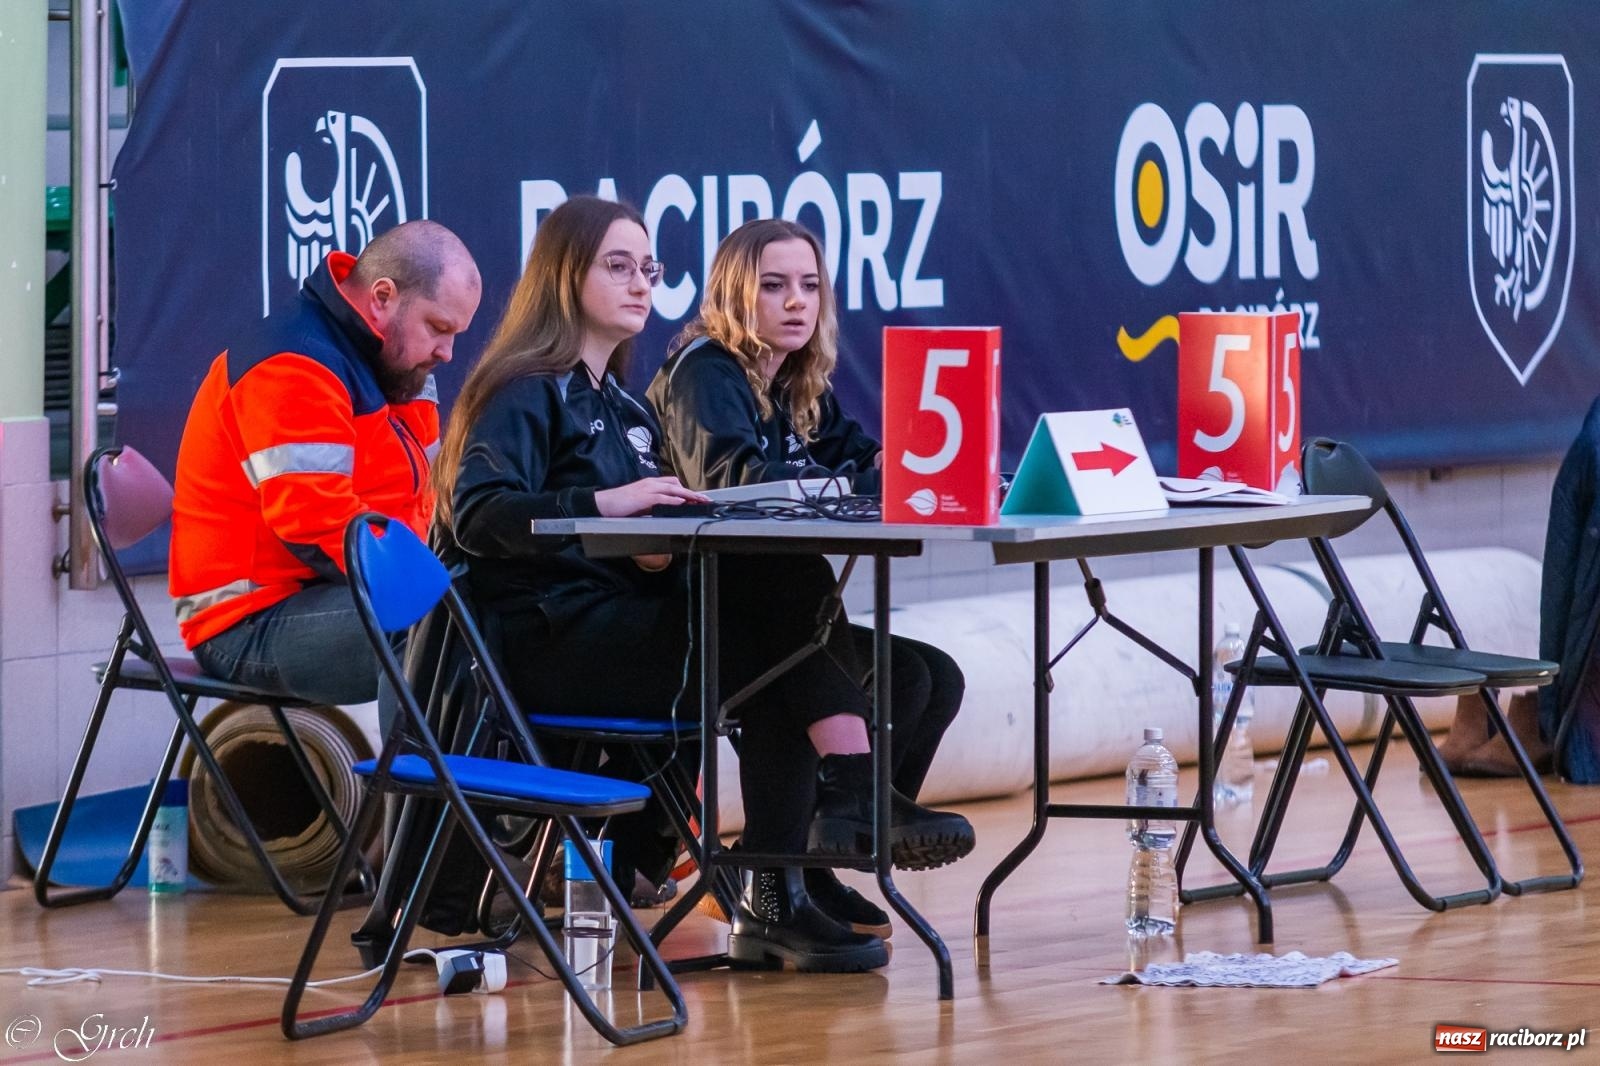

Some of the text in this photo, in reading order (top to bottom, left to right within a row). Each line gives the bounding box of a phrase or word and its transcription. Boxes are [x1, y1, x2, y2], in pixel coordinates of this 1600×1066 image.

[1115, 102, 1319, 286] OSiR
[901, 349, 970, 475] 5
[1193, 334, 1251, 452] 5
[1278, 332, 1297, 452] 5
